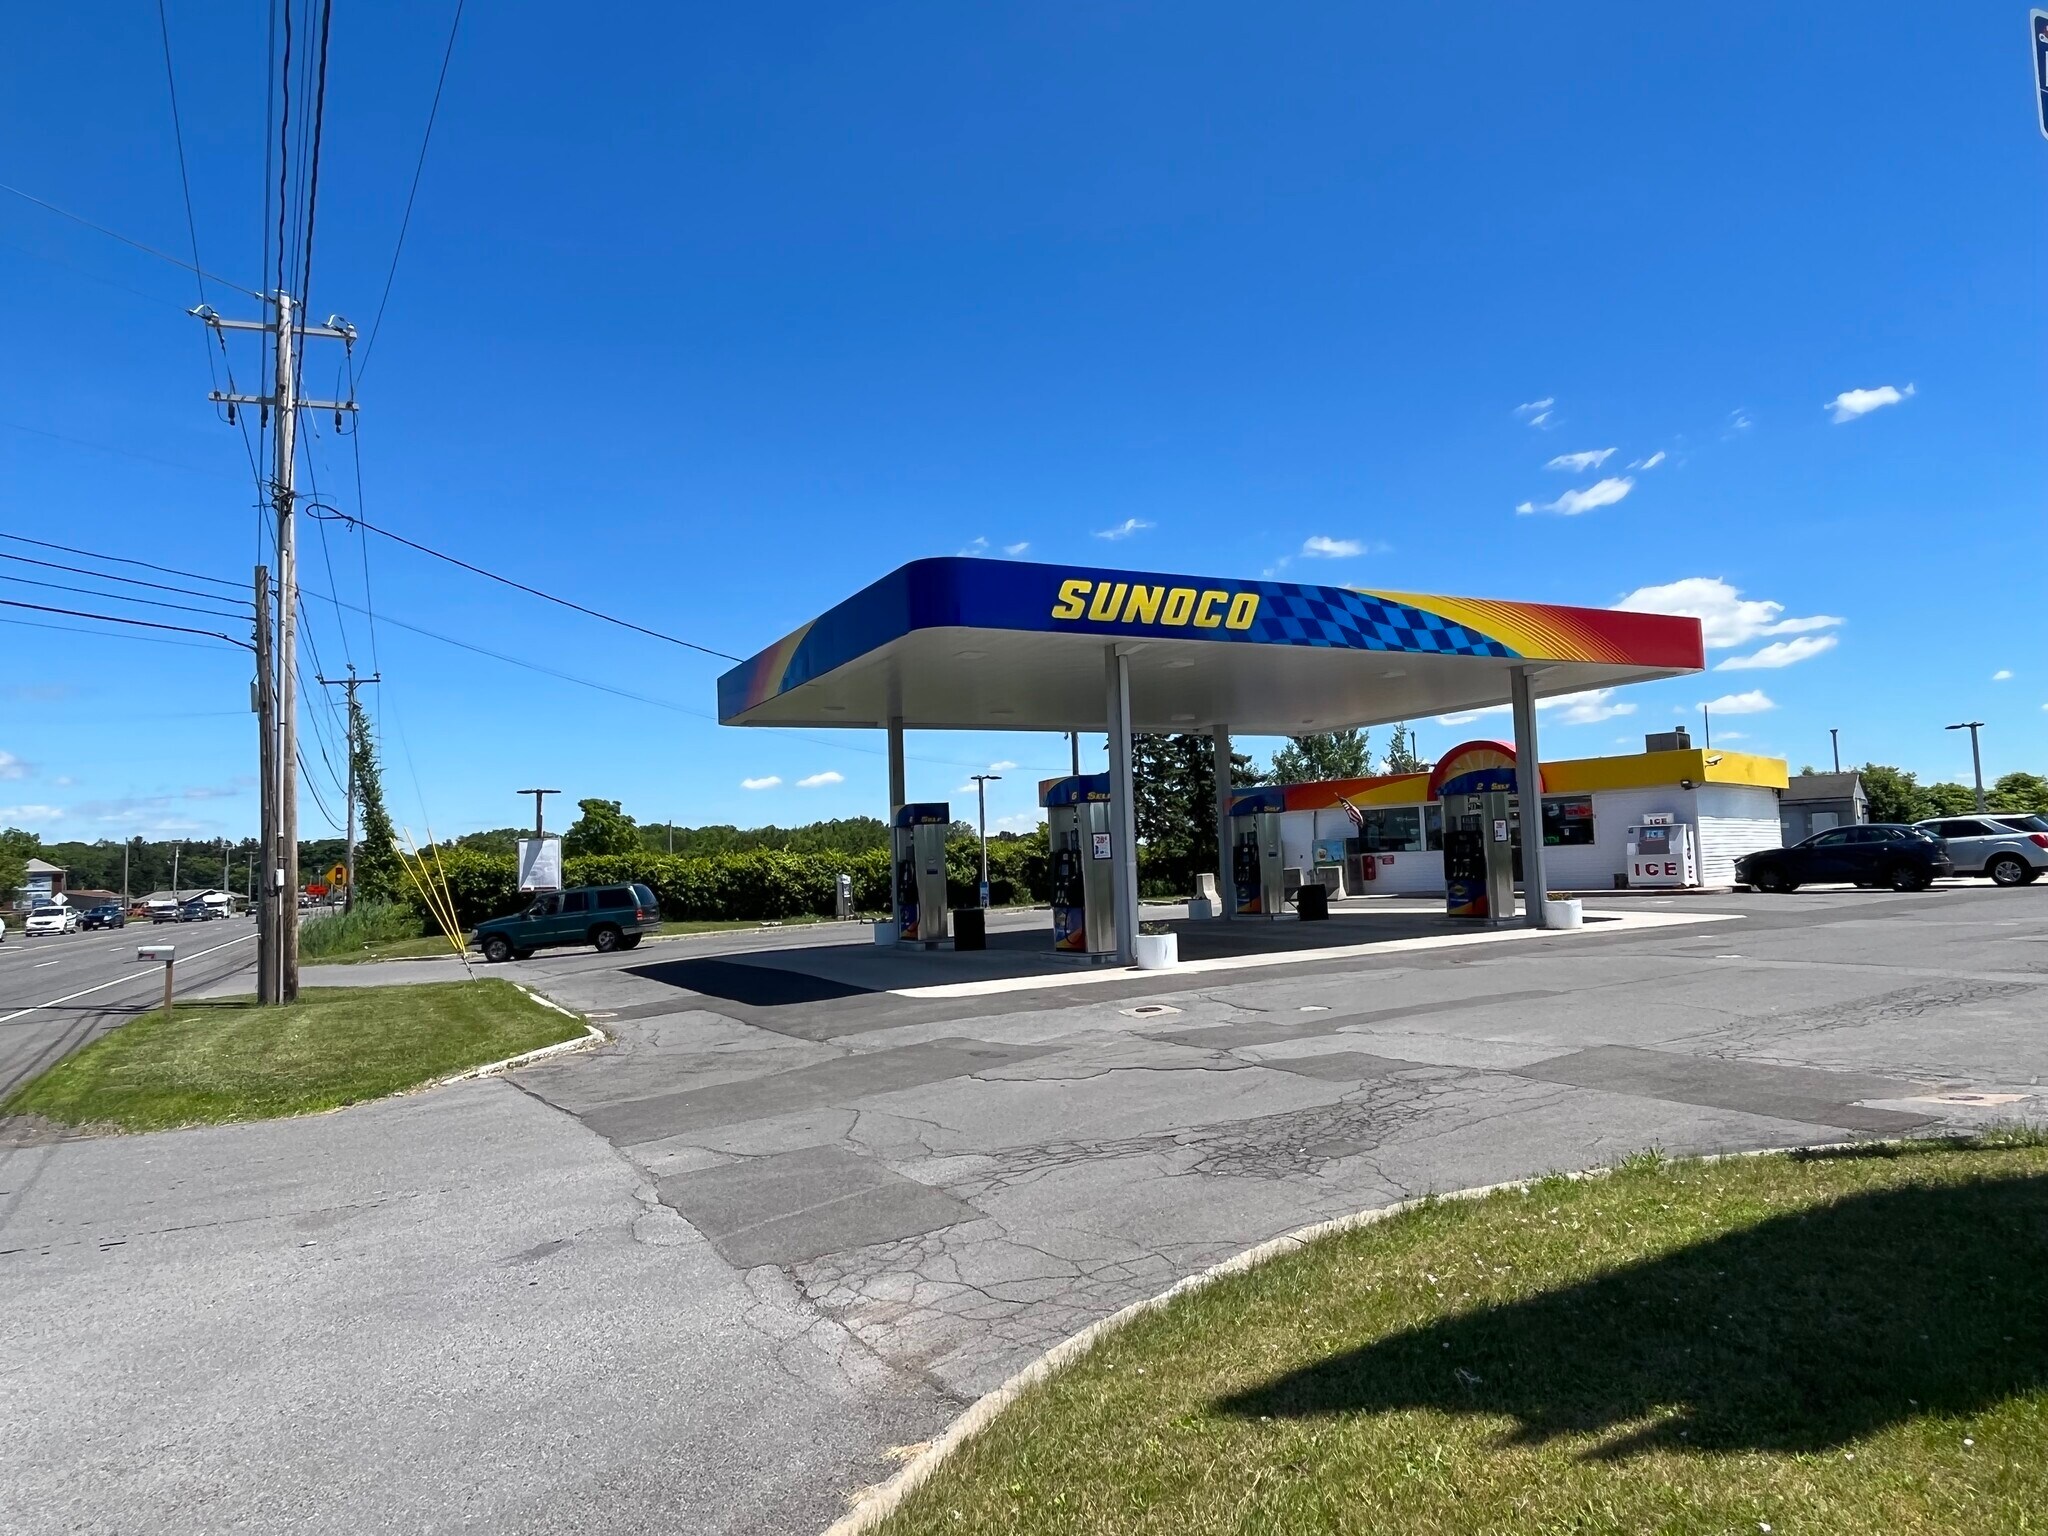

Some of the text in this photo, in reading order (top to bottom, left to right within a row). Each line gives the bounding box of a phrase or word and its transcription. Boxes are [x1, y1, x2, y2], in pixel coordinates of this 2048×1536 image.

[1051, 580, 1260, 630] SUNOCO
[1071, 792, 1077, 800] 6
[1634, 862, 1677, 876] ICE
